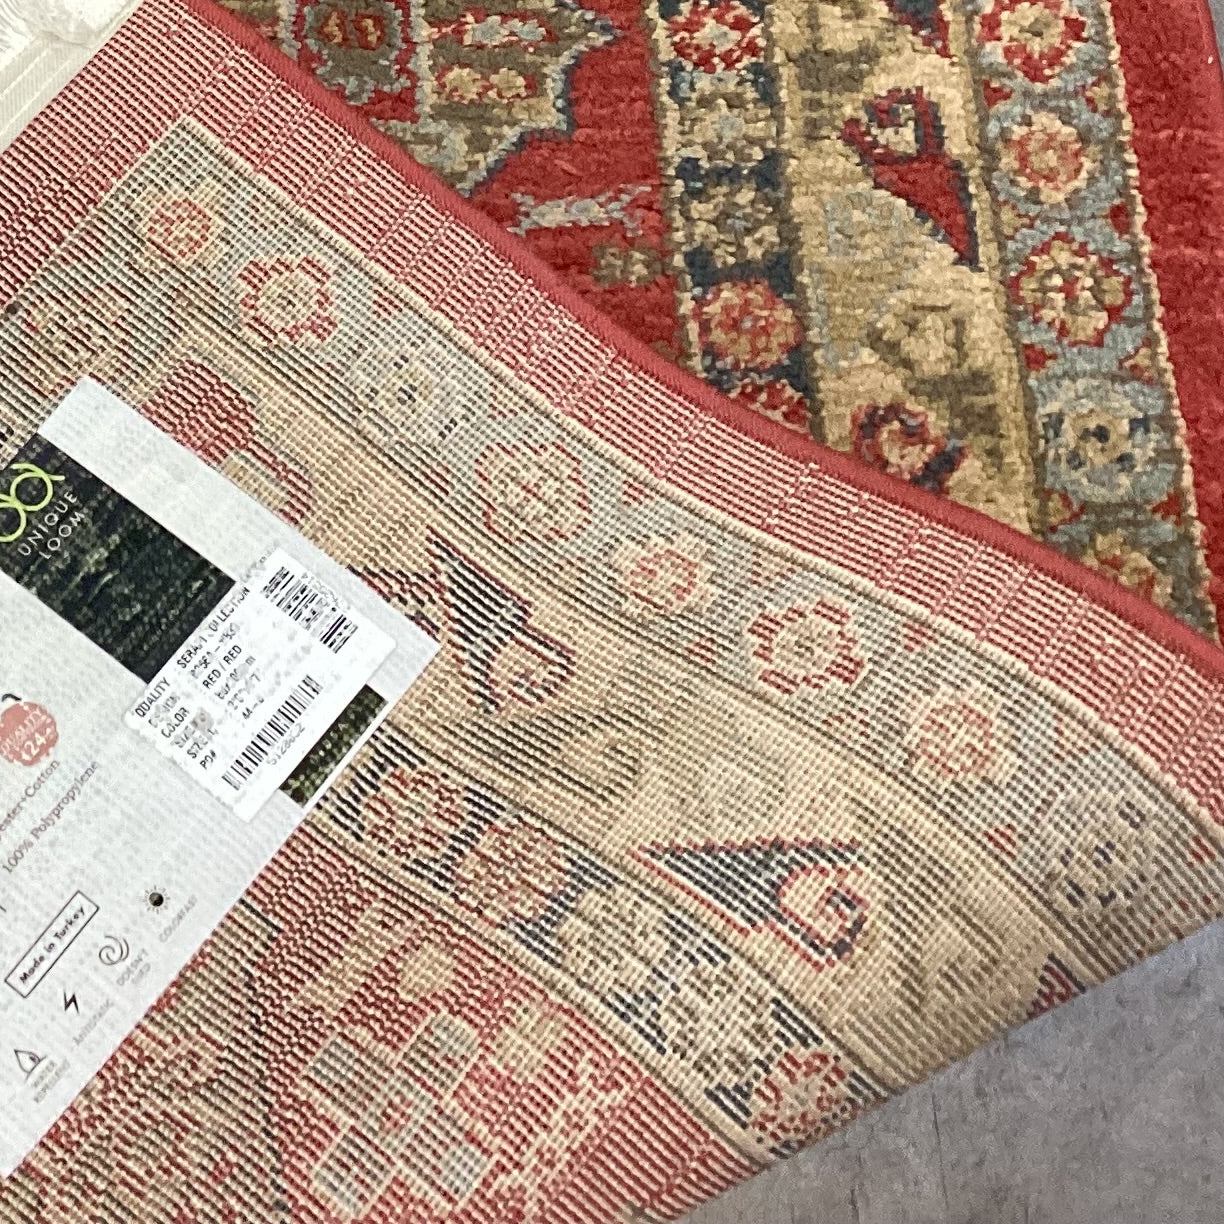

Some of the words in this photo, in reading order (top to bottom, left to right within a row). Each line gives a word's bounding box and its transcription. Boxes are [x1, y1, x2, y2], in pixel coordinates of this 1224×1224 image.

[15, 487, 80, 559] UNIQUE
[38, 508, 86, 561] LOOM
[202, 667, 222, 690] RED
[222, 643, 243, 665] RED
[134, 676, 171, 718] QUALITY
[160, 705, 190, 739] COLOR
[1, 836, 34, 874] 100%
[29, 758, 102, 841] Polypropylene
[18, 950, 46, 984] Made
[52, 903, 87, 941] Turkey
